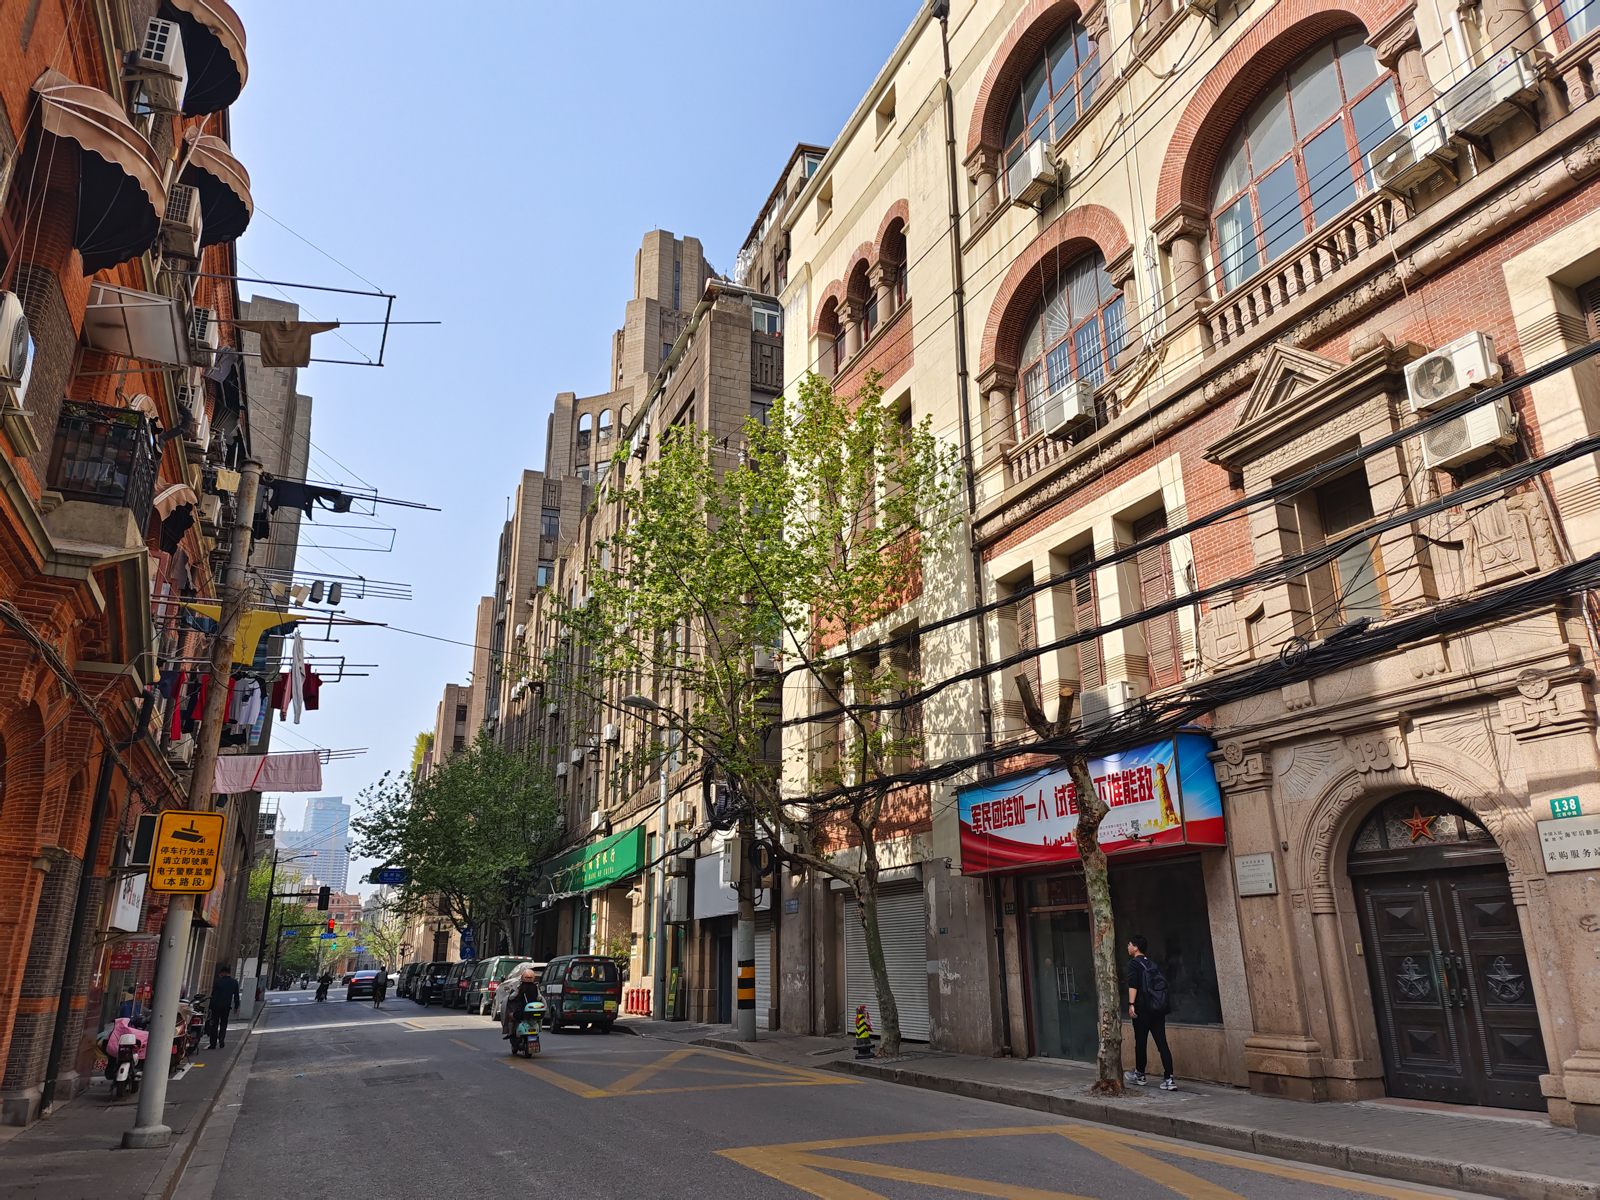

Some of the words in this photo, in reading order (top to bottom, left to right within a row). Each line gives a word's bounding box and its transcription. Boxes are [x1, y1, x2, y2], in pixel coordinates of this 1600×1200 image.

[1355, 736, 1402, 763] 1907
[970, 790, 1049, 834] 军民团结如一人
[1054, 765, 1155, 818] 试看下谁能敌
[1554, 798, 1577, 813] 138
[160, 846, 215, 857] 停车行为违法
[162, 856, 210, 866] 请立即驶离
[157, 866, 213, 876] 电子警察监管
